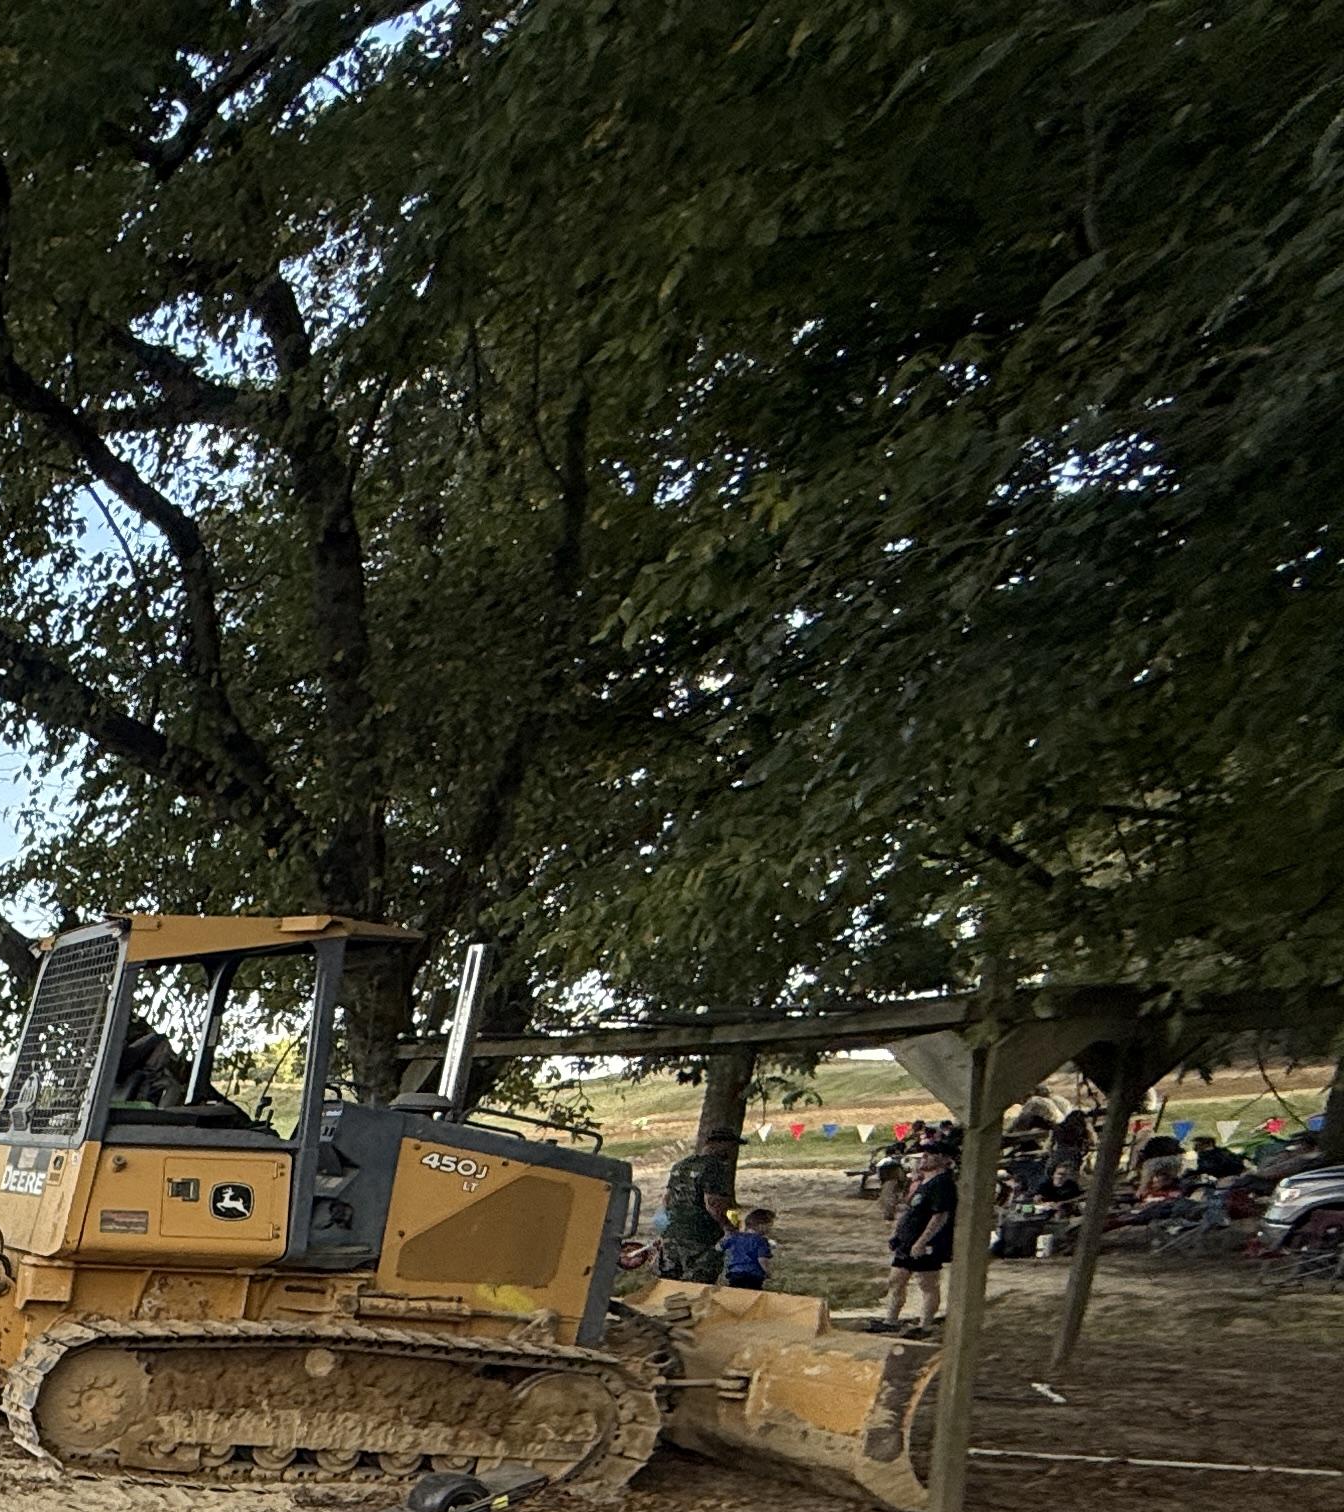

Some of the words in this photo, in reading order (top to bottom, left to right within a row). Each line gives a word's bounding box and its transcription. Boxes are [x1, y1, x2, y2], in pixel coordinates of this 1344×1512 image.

[0, 1164, 47, 1196] DEERE
[421, 1152, 490, 1180] 450J
[462, 1180, 480, 1193] LT
